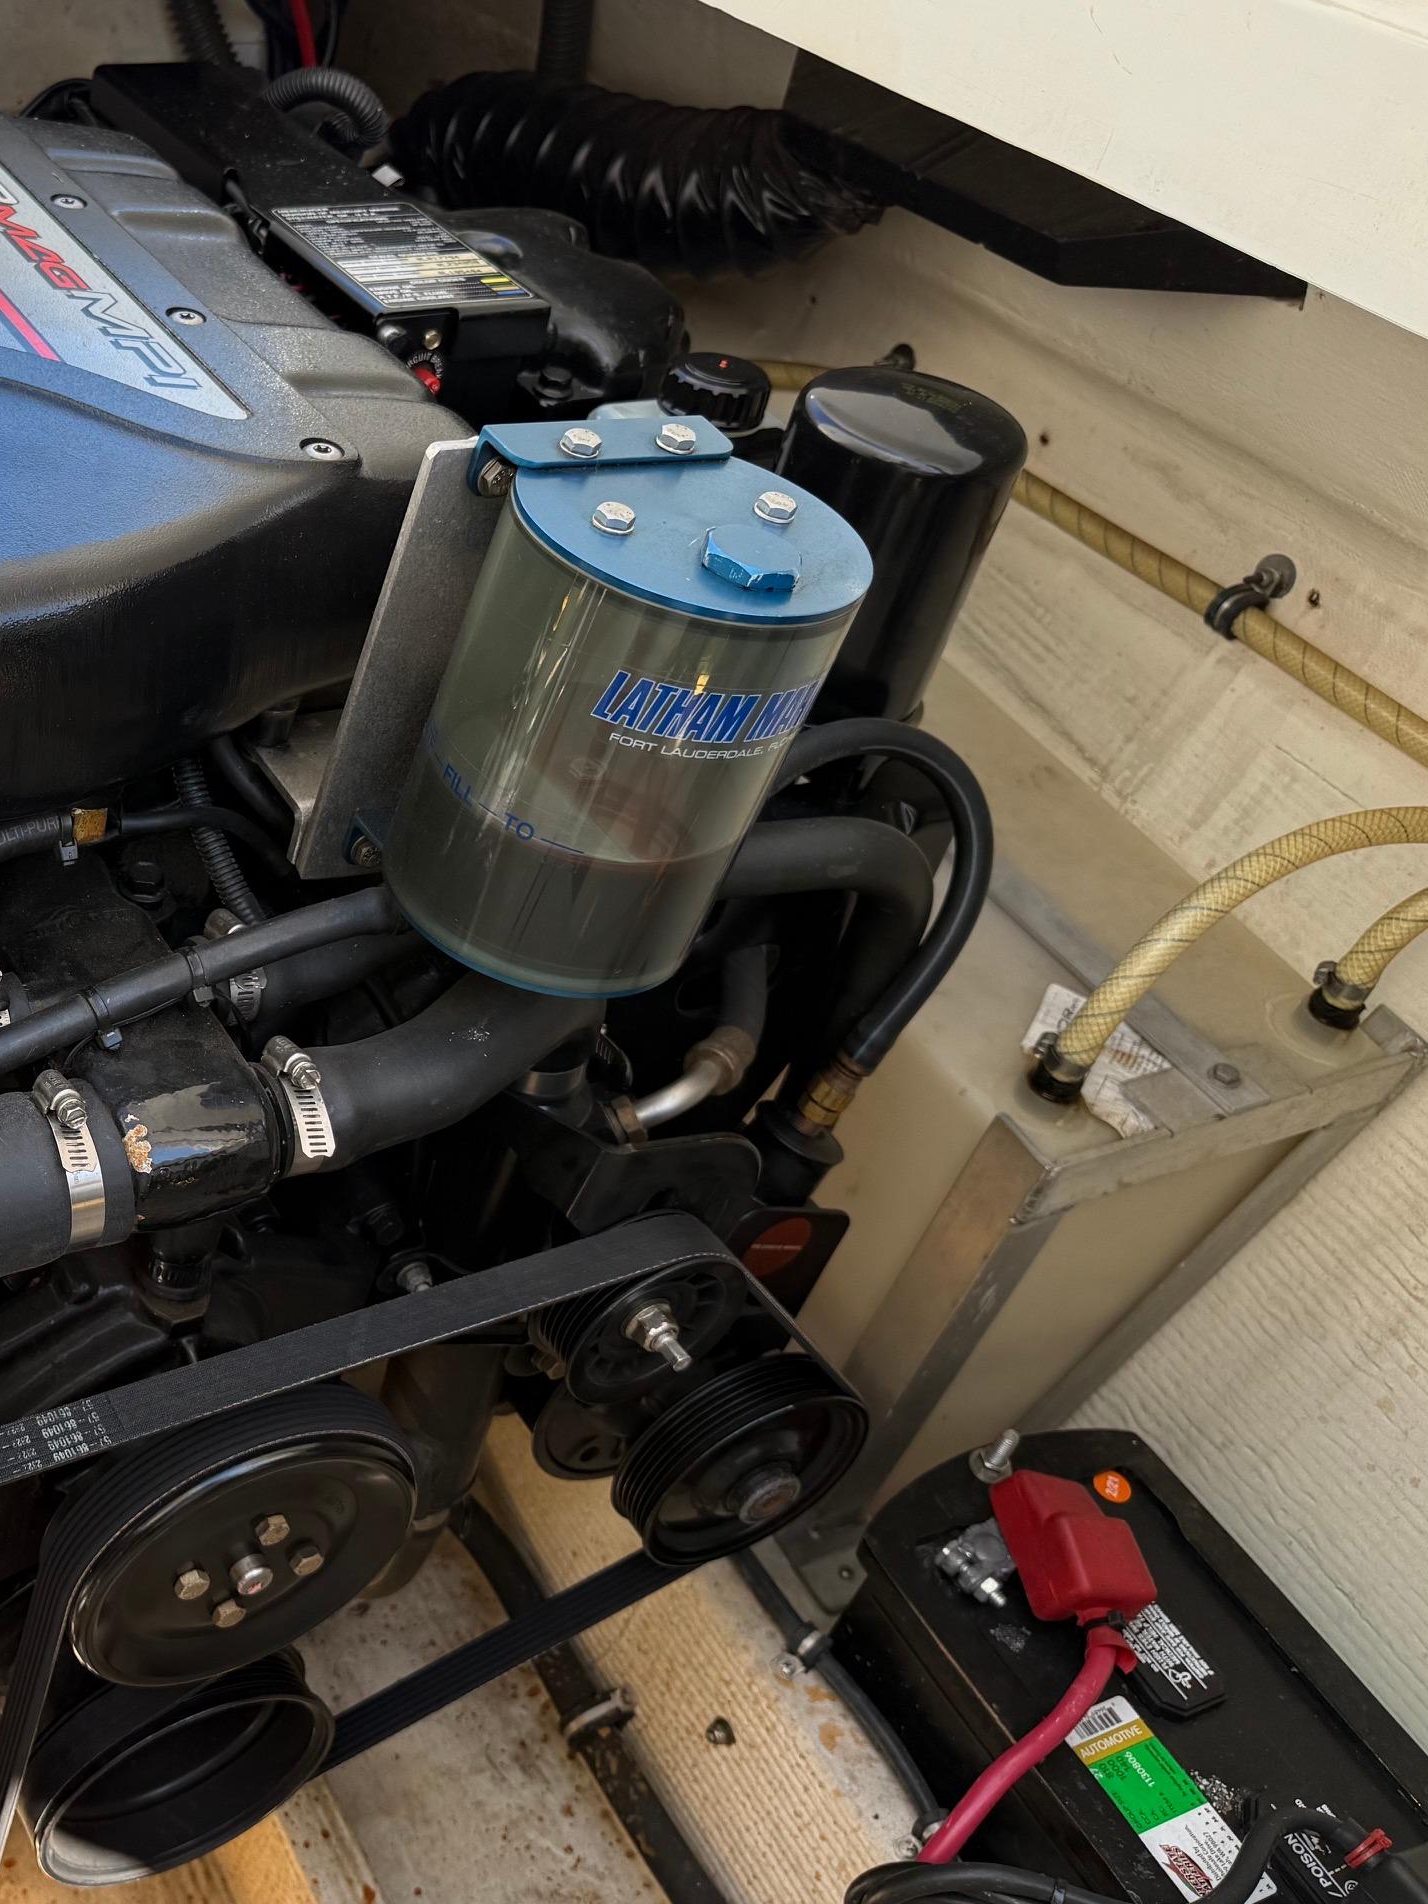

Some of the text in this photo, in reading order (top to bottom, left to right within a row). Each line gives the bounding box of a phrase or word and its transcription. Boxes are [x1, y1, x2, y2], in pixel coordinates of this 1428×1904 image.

[590, 669, 762, 744] LATHAM
[609, 732, 658, 752] FORT
[505, 811, 535, 841] TO
[1079, 1723, 1143, 1758] AUTOMOTIVE
[1123, 1749, 1156, 1788] 1130806
[1172, 1847, 1211, 1891] ATTERIES
[1283, 1833, 1332, 1887] POISON
